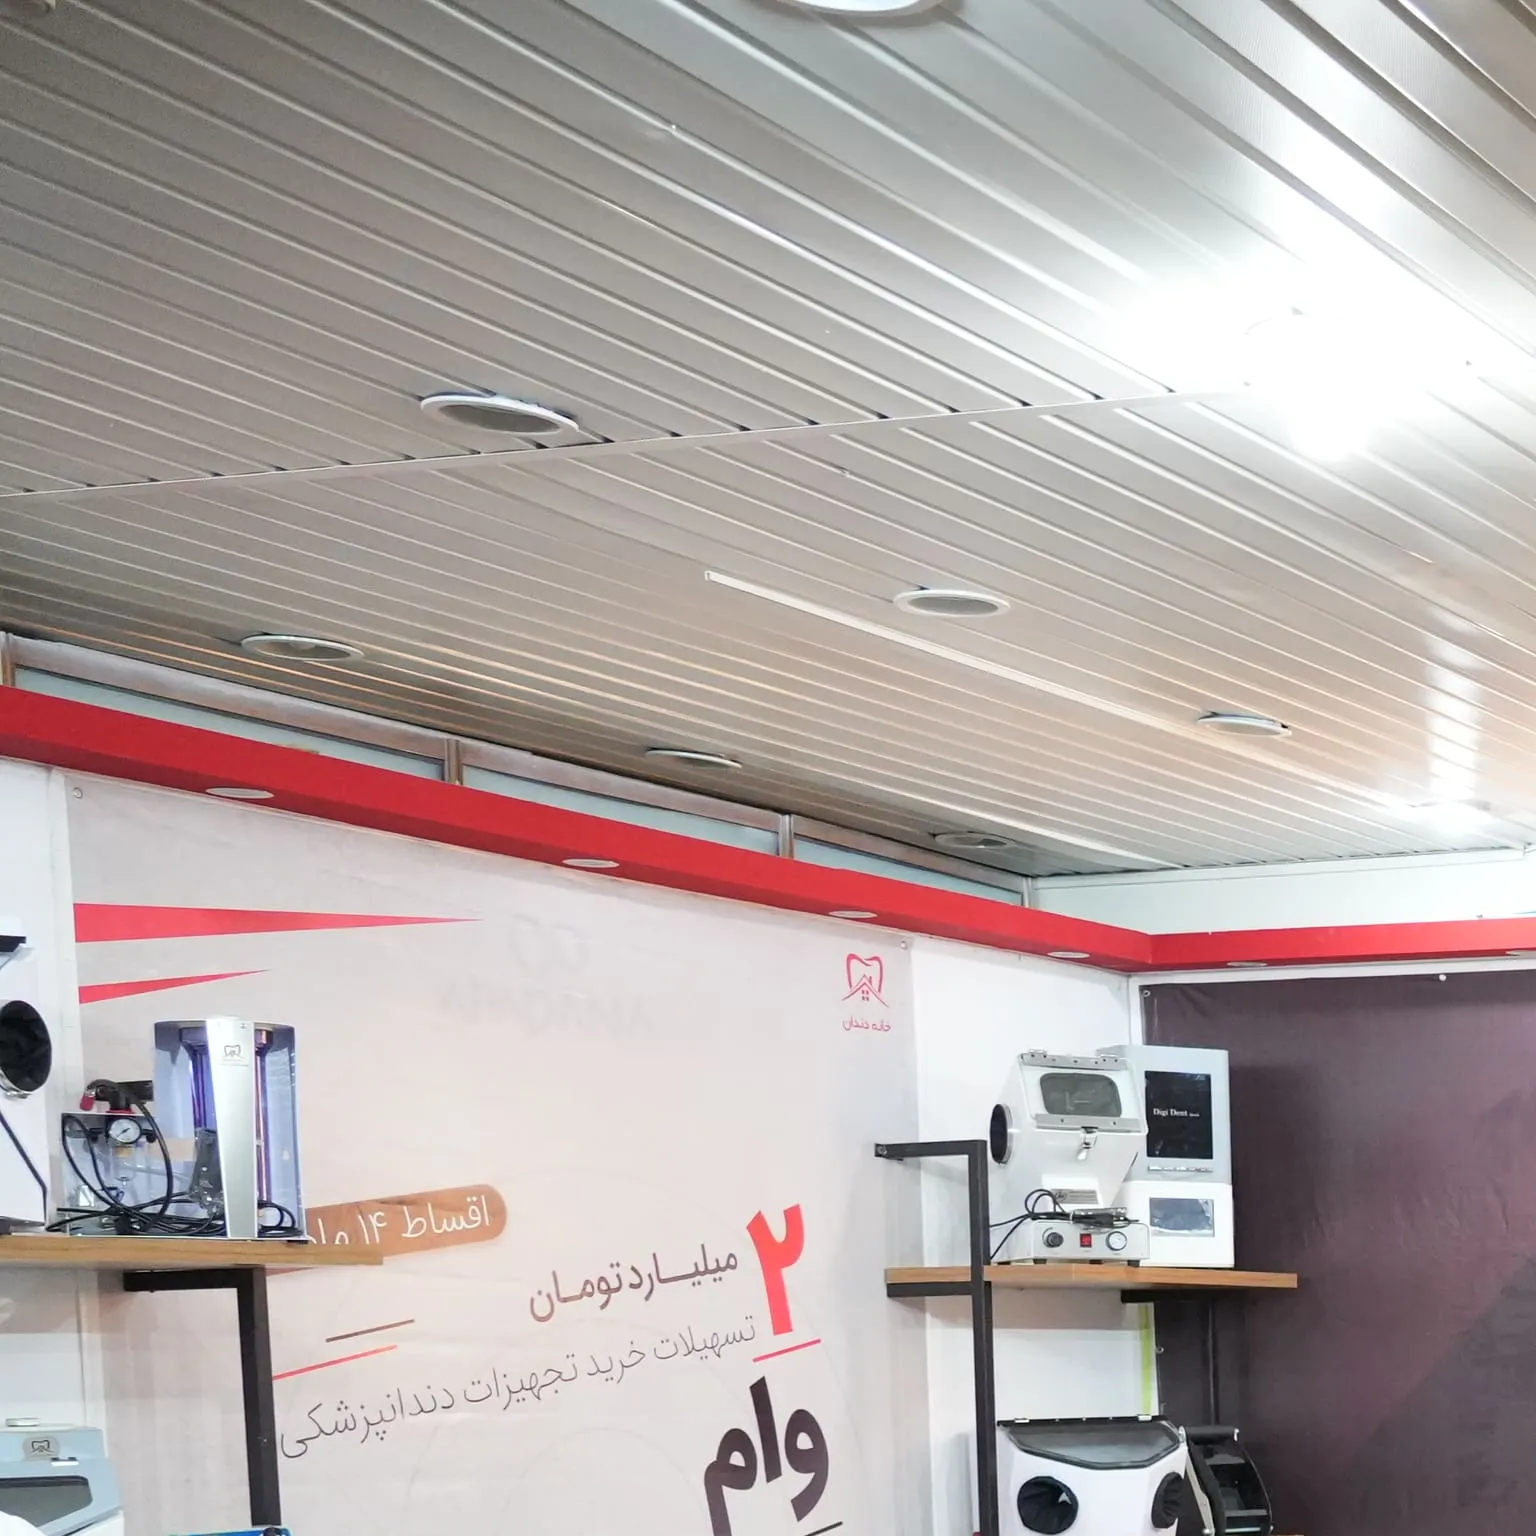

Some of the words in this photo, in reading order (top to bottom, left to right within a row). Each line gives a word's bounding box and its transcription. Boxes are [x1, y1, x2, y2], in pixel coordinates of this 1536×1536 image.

[1153, 1108, 1168, 1117] Digi
[1170, 1109, 1188, 1117] Dent
[402, 1194, 491, 1239] اقساط
[653, 1315, 756, 1360] تسهیلات
[464, 1354, 578, 1411] تجهیزات
[587, 1340, 646, 1384] خرید
[279, 1386, 456, 1459] دندانپزشکی
